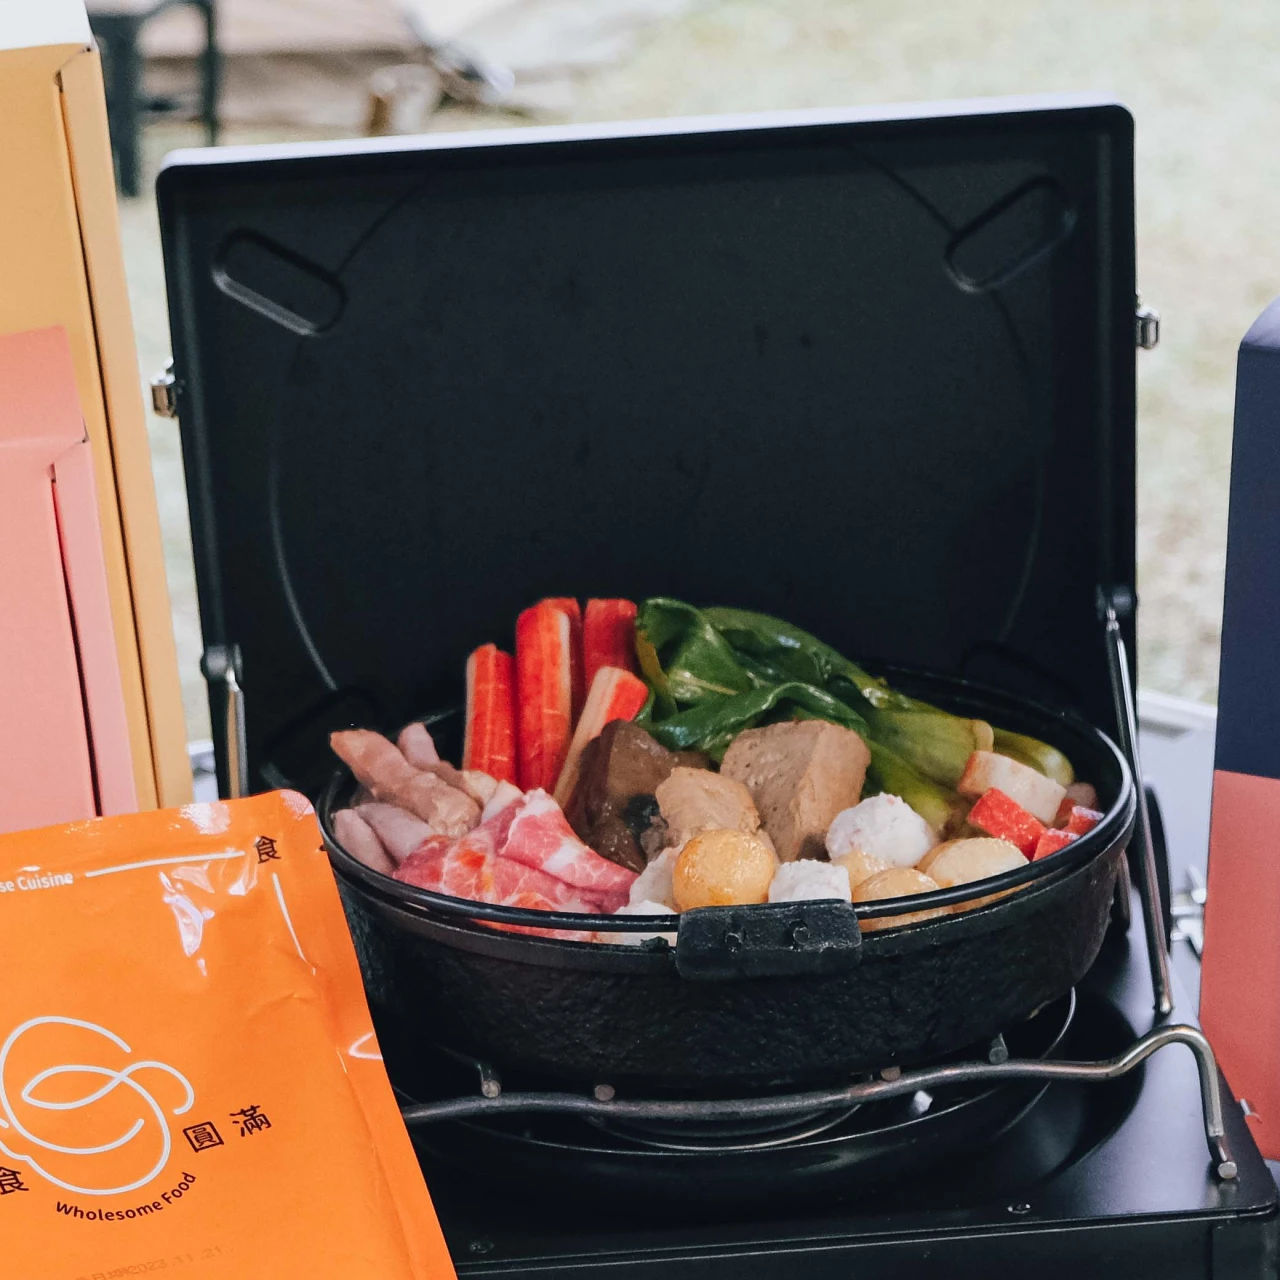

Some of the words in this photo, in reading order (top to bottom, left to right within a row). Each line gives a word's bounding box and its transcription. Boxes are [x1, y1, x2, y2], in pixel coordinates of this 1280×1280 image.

[254, 834, 281, 864] 食
[17, 871, 74, 890] Cuisine
[56, 1200, 164, 1221] Wholesome
[161, 1171, 197, 1205] Food
